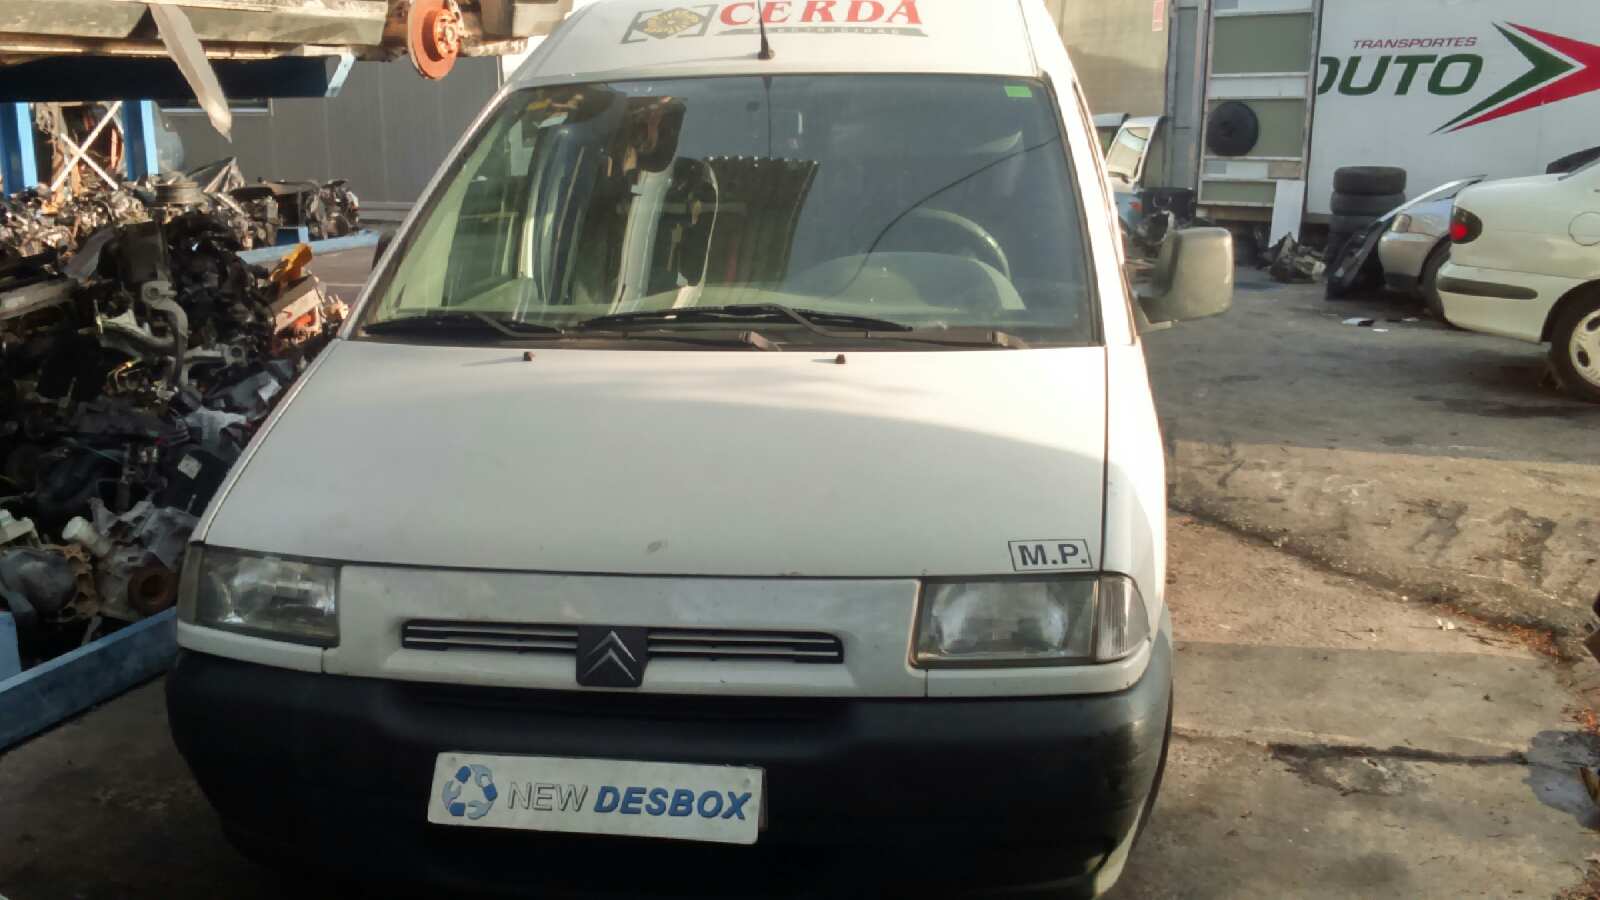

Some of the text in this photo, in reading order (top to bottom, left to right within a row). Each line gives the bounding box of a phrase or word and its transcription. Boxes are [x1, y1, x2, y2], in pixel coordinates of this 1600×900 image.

[1353, 37, 1478, 49] TRANSPORTES
[1018, 543, 1087, 566] M.P.
[507, 781, 752, 821] NEW DESBOX
